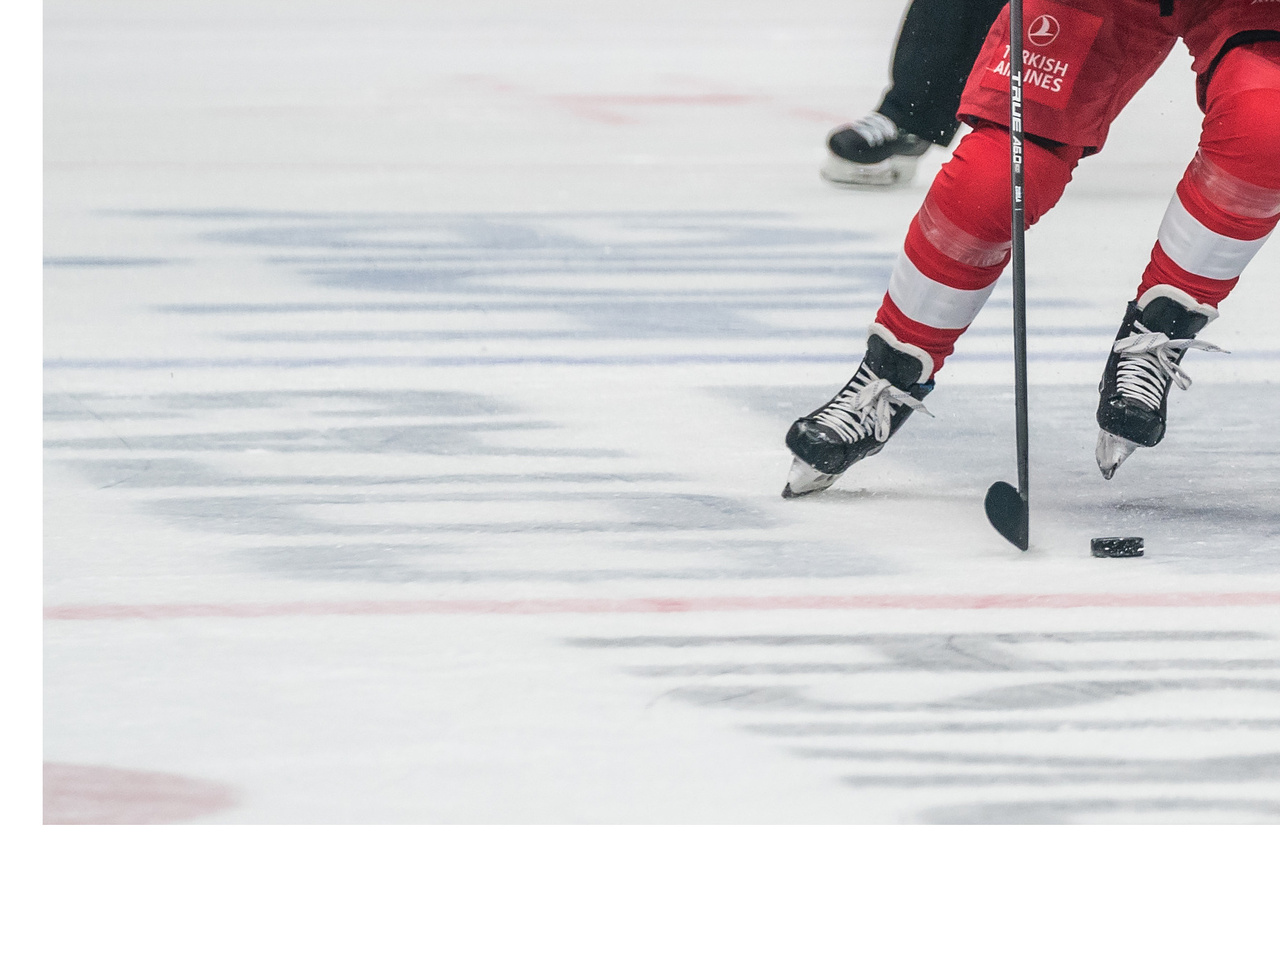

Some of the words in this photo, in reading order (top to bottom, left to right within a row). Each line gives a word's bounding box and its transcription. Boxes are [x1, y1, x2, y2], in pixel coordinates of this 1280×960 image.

[993, 60, 1063, 93] AIINES
[1003, 44, 1069, 77] TRKISH
[1011, 70, 1022, 133] TRUE
